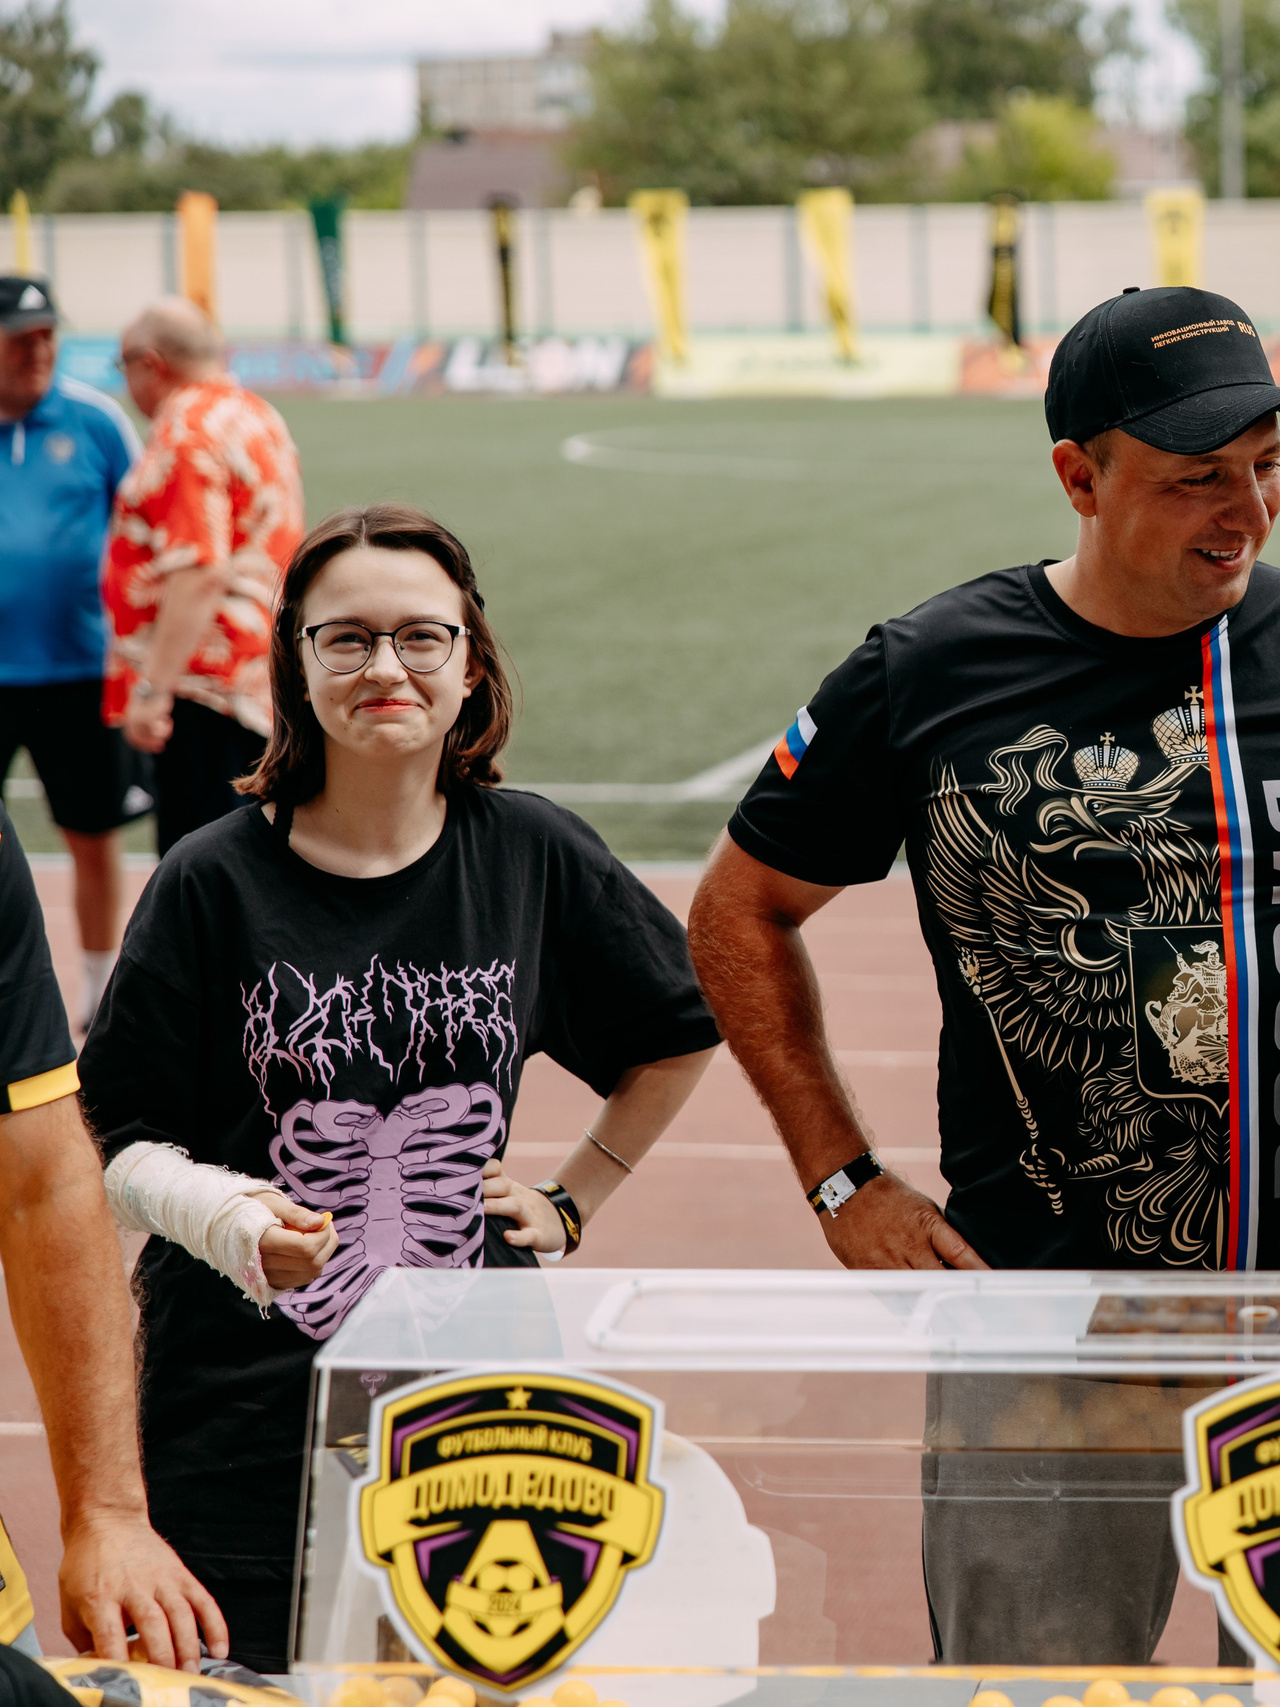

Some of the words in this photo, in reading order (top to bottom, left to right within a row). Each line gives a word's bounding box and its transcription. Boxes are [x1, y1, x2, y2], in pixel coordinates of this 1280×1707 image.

[1151, 319, 1216, 342] ИННОВАЦИОННЫЙ
[1154, 336, 1181, 349] ЛЕГКИХ
[1181, 325, 1229, 340] КОНСТРУКЦИЙ
[1237, 321, 1256, 338] RUS
[437, 1424, 549, 1459] ФУТБОЛЬНЫЙ
[549, 1429, 593, 1462] КЛУБ
[408, 1468, 617, 1520] ДОМОДЕДОВО
[488, 1595, 523, 1612] 2024
